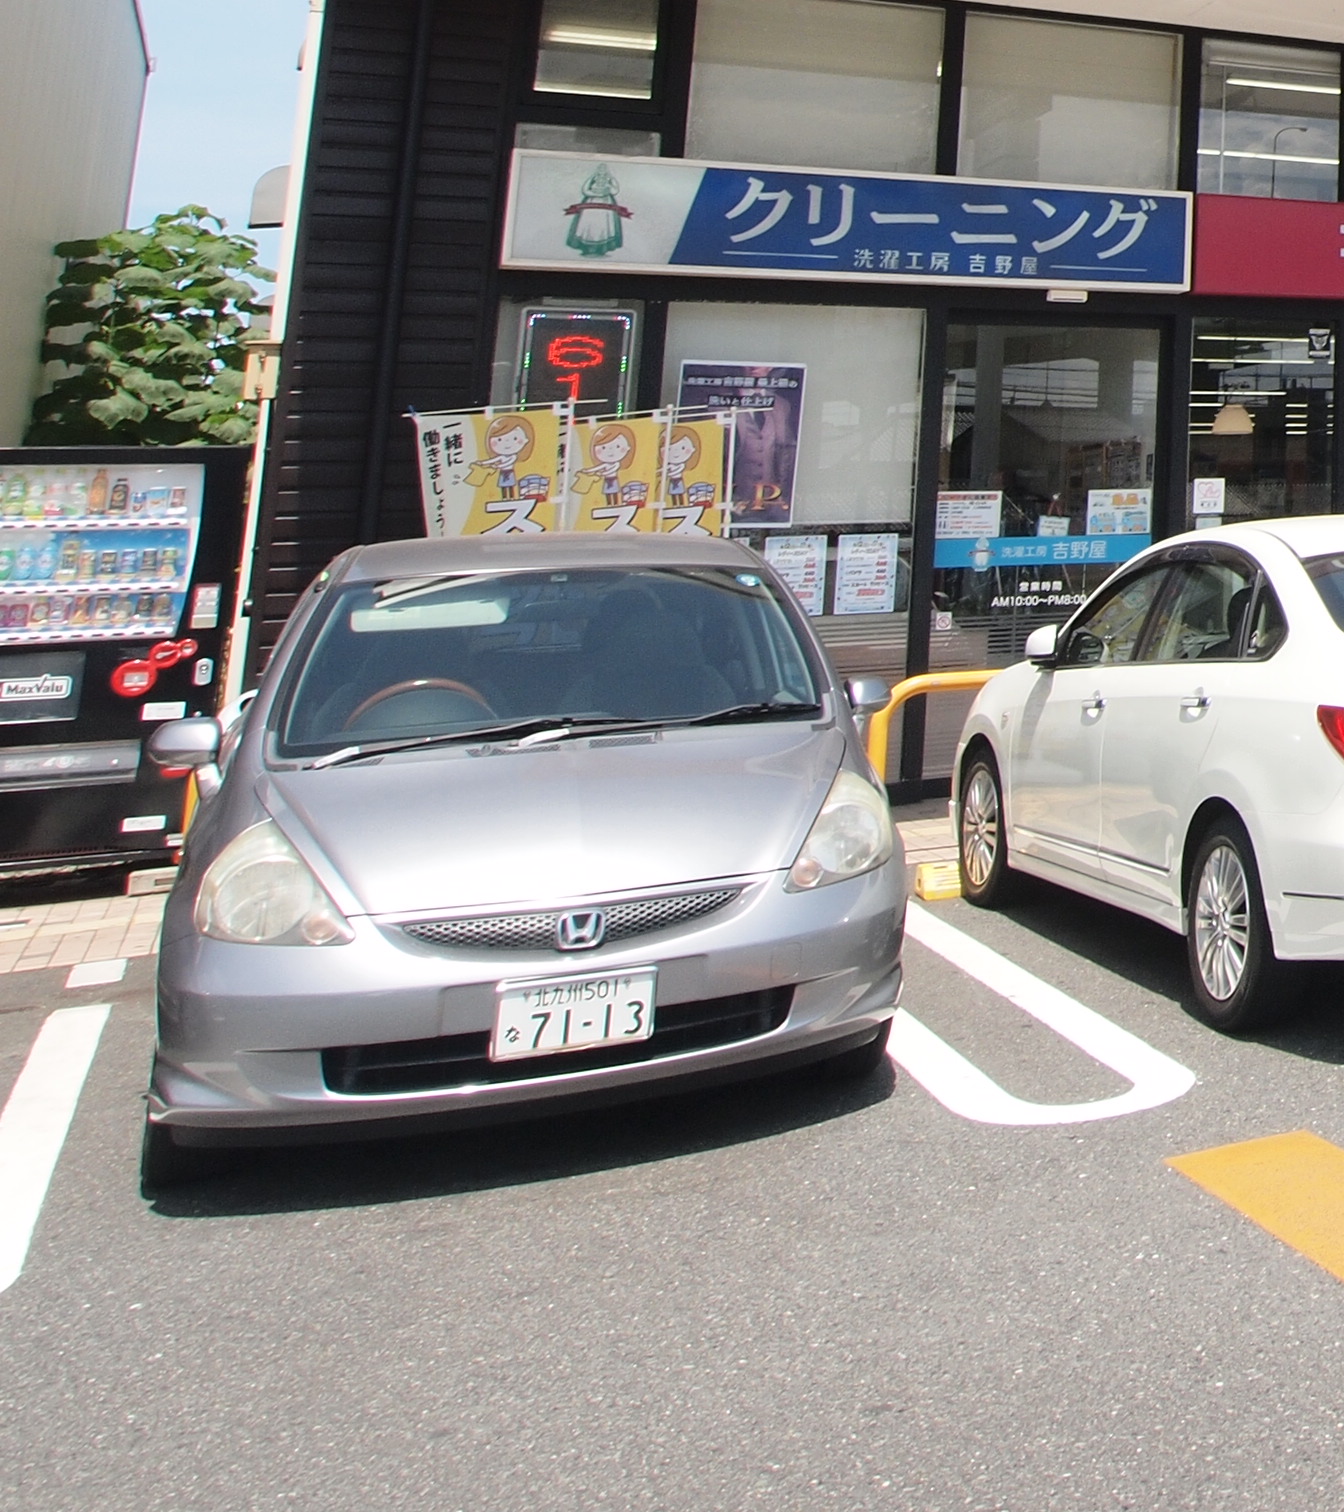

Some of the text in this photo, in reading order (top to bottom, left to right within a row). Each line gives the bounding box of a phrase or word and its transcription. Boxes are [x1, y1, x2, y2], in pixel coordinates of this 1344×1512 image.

[723, 176, 1158, 260] クリーニング
[853, 249, 1038, 275] 洗濯工房 吉野屋
[442, 422, 464, 467] 一緒に
[1001, 541, 1107, 559] 洗濯工房 吉野屋
[5, 676, 64, 695] MaxValu
[534, 979, 618, 1007] 北九州501
[504, 1000, 645, 1049] な 71-13
